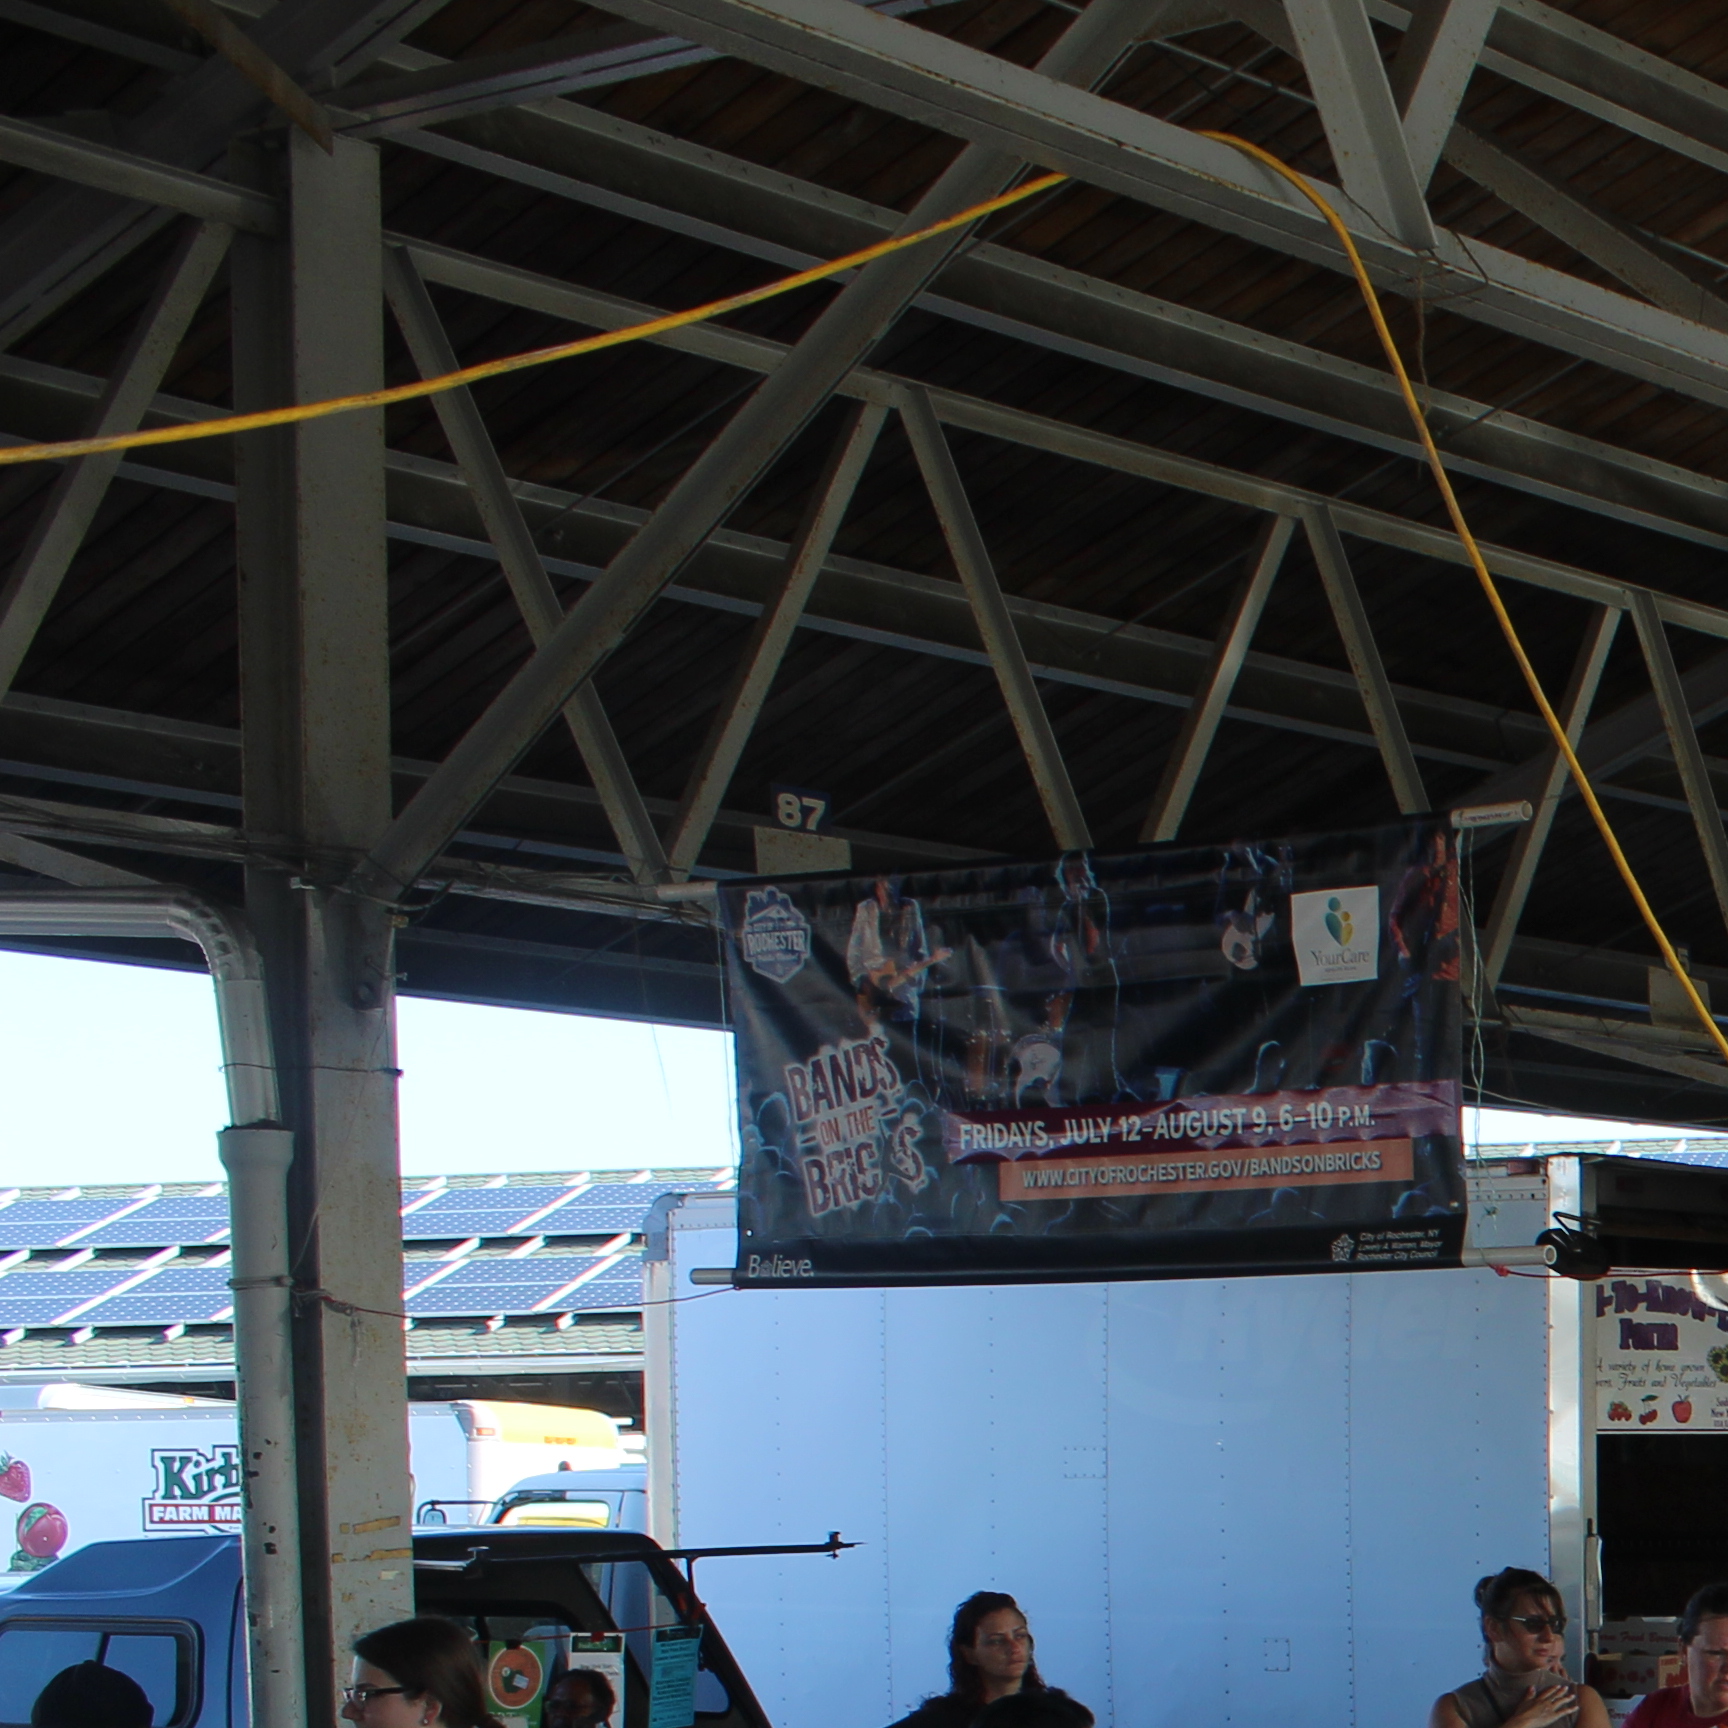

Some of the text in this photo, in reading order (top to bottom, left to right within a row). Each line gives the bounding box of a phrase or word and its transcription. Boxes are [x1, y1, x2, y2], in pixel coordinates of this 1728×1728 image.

[777, 792, 826, 831] 87
[1310, 949, 1370, 966] YourCare
[784, 1036, 902, 1121] BANDS
[819, 1104, 876, 1146] ON THE
[959, 1121, 1055, 1150] FRIDAYS,
[1059, 1116, 1112, 1145] JULY
[1252, 1105, 1275, 1135] 9,
[1337, 1104, 1376, 1127] P.M.
[1022, 1151, 1381, 1189] WWW.CITYOFROCHESTER.GOV/BANDSONBRICKS
[1359, 1229, 1440, 1243] City of Rochester, NY
[1419, 1240, 1443, 1250] Mayor
[1356, 1250, 1438, 1261] Rochester City Council
[1608, 1360, 1637, 1374] variety
[1641, 1358, 1651, 1374] of
[1655, 1358, 1677, 1372] home
[1680, 1362, 1705, 1375] grown
[1617, 1372, 1647, 1391] Fruits
[1651, 1376, 1667, 1388] and
[1671, 1371, 1717, 1391] Vegetables
[1711, 1408, 1724, 1417] New
[152, 1505, 210, 1521] FARM
